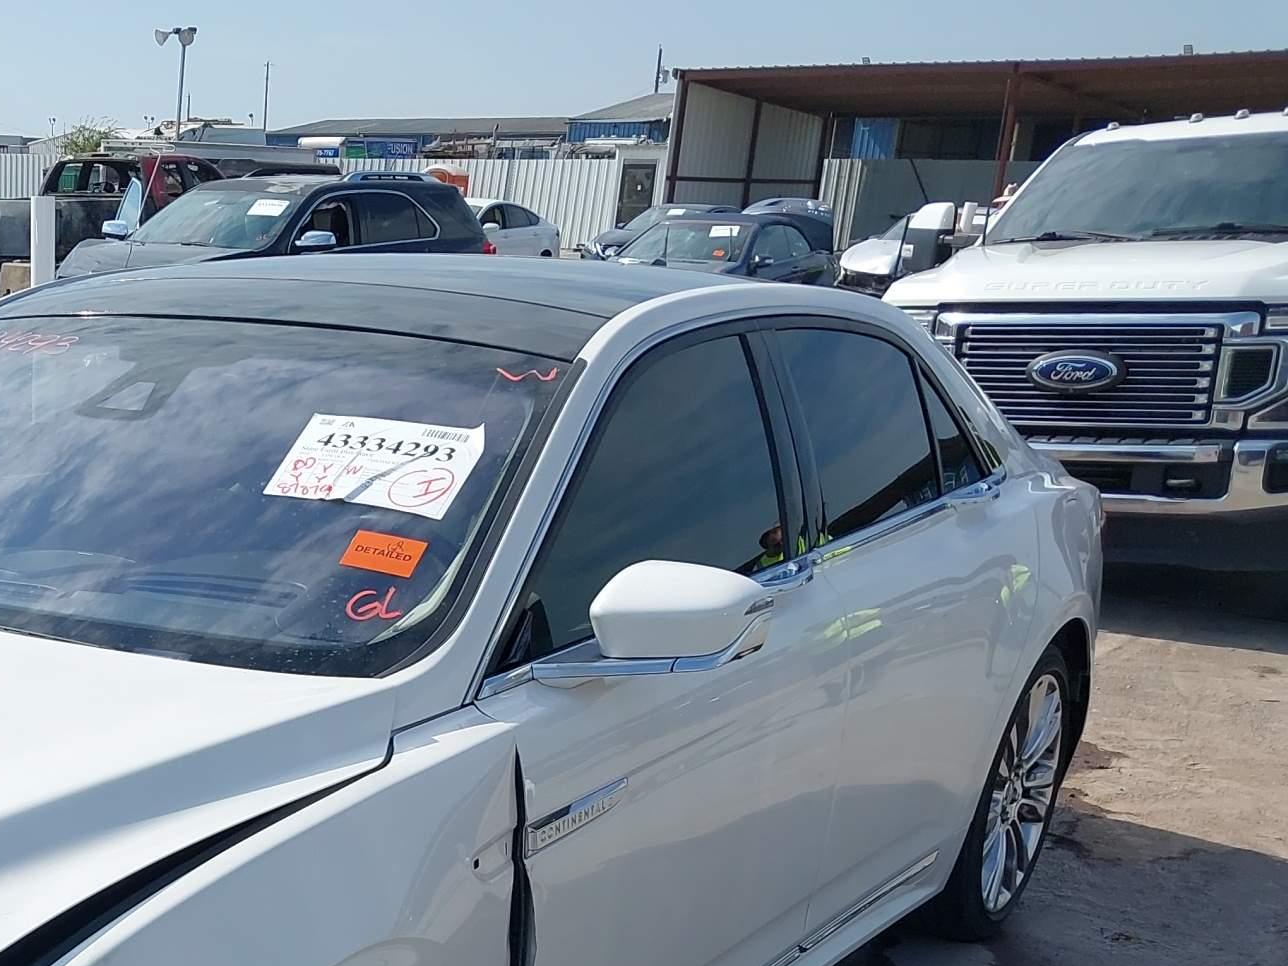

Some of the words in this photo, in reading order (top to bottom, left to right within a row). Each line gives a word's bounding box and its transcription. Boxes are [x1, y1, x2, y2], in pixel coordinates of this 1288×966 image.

[983, 280, 1099, 291] SUPER
[1109, 280, 1211, 290] DUTY
[1050, 362, 1097, 382] Ford
[316, 432, 456, 462] 43334293
[354, 544, 412, 562] DETAILED
[539, 799, 606, 843] CONTINENTAL
